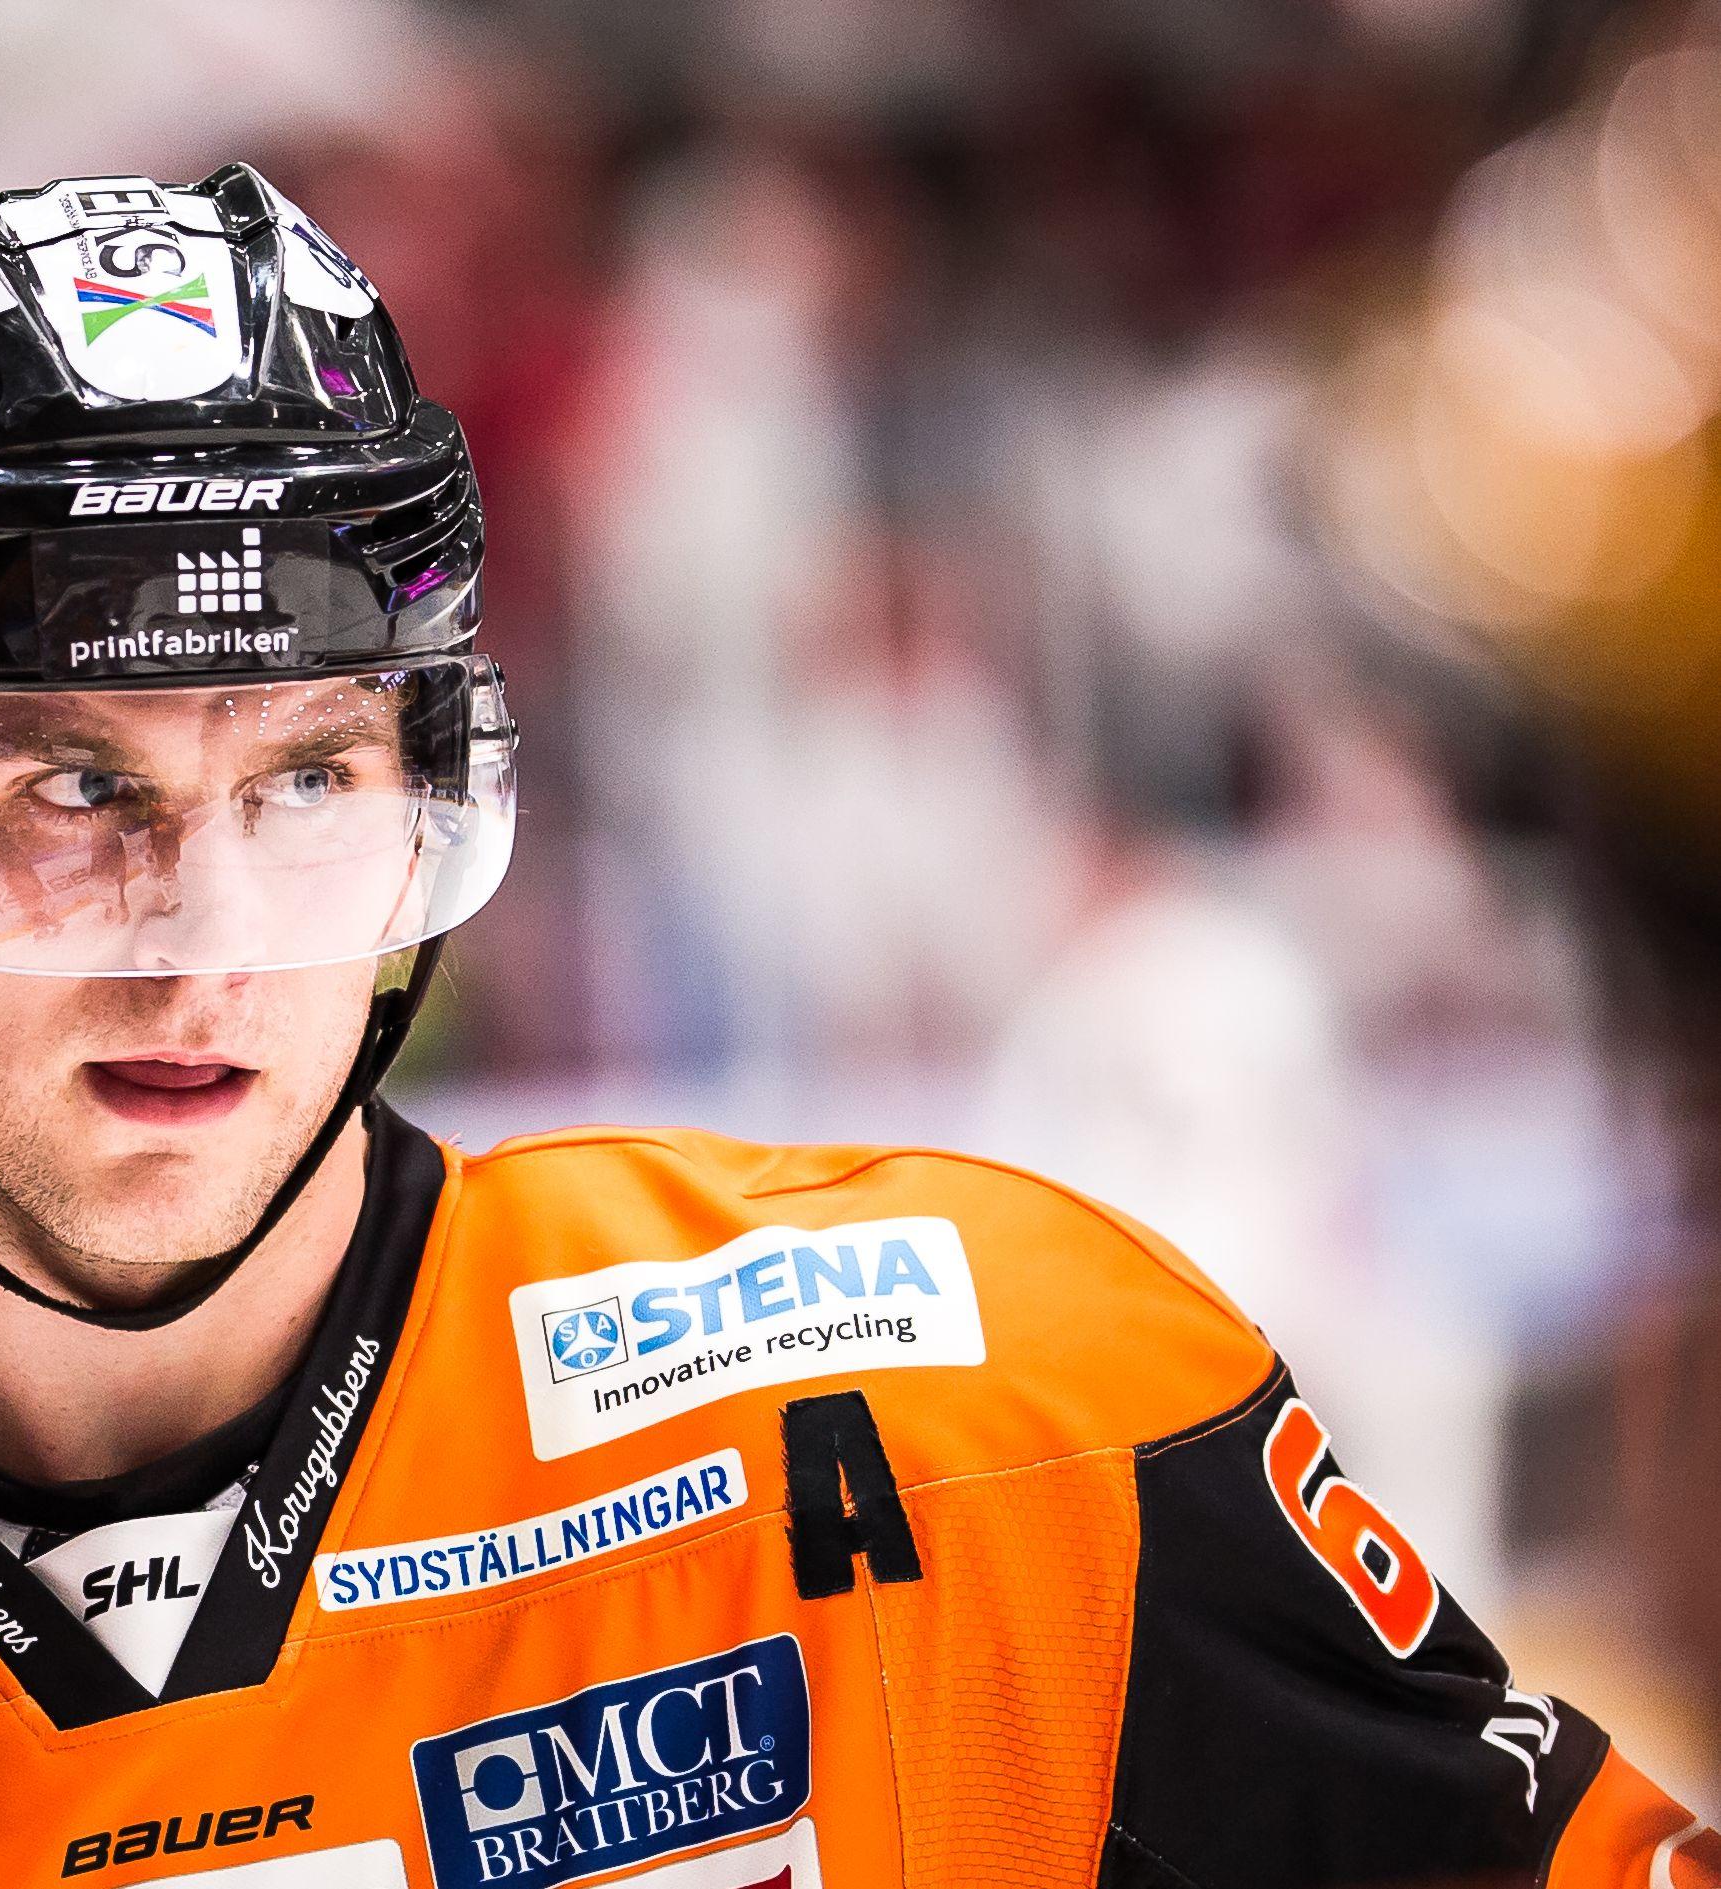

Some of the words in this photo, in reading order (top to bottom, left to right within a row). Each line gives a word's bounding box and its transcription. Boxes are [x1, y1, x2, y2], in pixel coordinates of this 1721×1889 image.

[69, 480, 286, 516] BAUER
[70, 628, 290, 667] printfabriken
[631, 1239, 940, 1356] STENA
[593, 1345, 752, 1413] Innovative
[766, 1313, 917, 1353] recycling
[244, 1335, 380, 1588] Korvgubbens
[779, 1389, 924, 1599] A
[331, 1465, 733, 1605] SYDSTÄLLNINGAR
[1263, 1398, 1440, 1660] 6
[82, 1554, 202, 1622] SHL
[60, 1794, 314, 1879] BAUER
[471, 1759, 785, 1882] BRATTBERG
